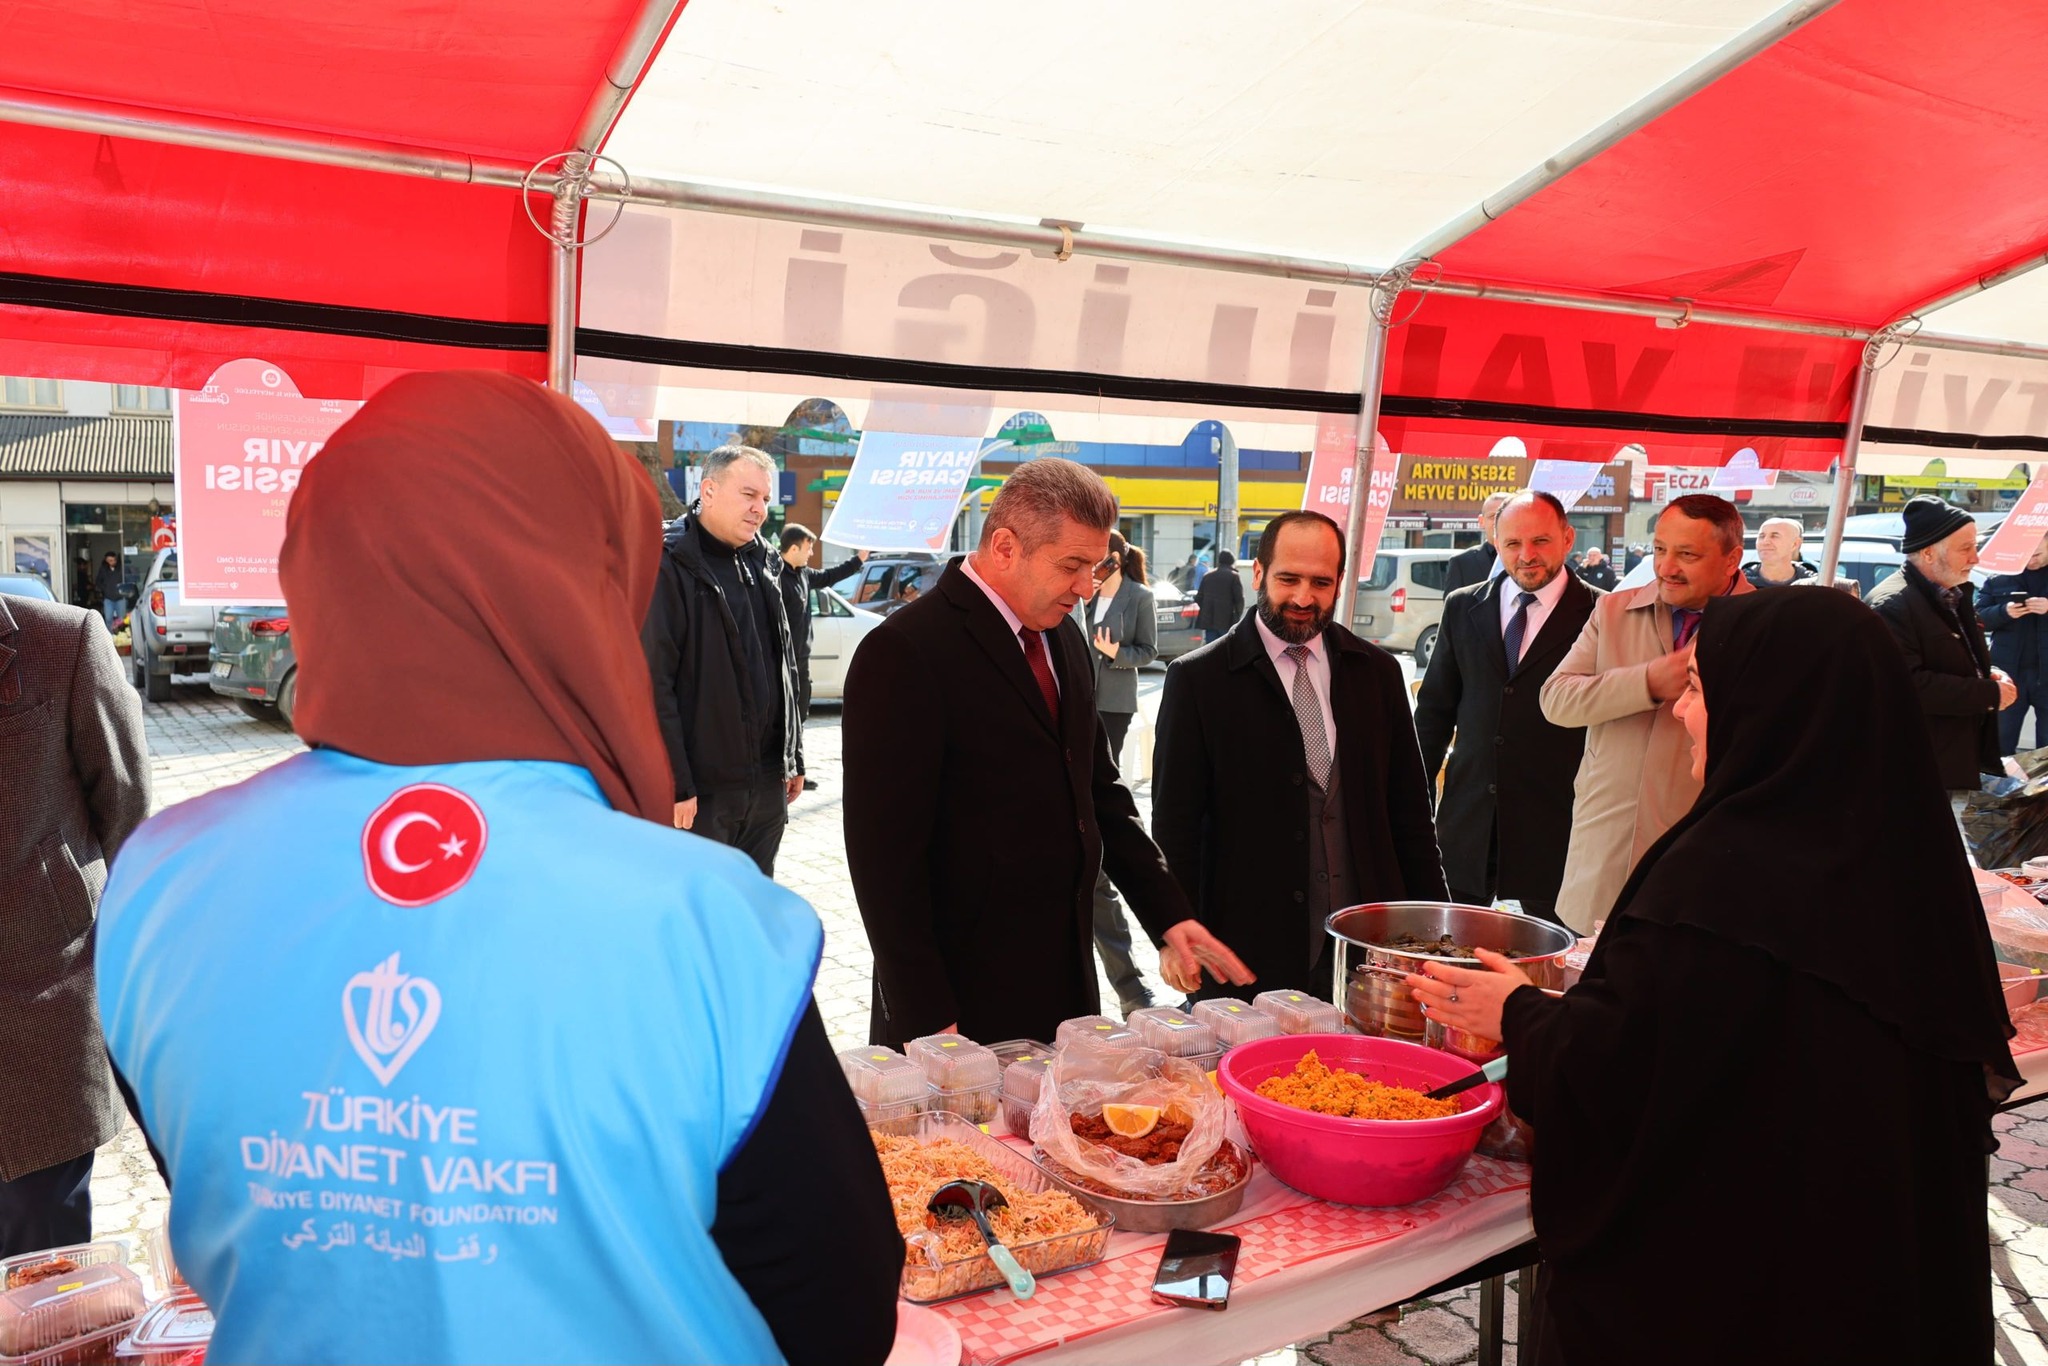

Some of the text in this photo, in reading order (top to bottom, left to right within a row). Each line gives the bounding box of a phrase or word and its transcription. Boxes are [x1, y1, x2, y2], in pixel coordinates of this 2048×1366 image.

[1411, 462, 1468, 480] ARTVİN
[1471, 464, 1517, 482] SEBZE
[1404, 484, 1455, 500] MEYVE
[301, 1087, 478, 1145] TÜRKİYE
[240, 1131, 558, 1196] DİYANET VAKFI
[319, 1191, 402, 1218] DIYANET
[410, 1202, 558, 1226] FOUNDATION
[281, 1218, 356, 1250] التركي
[364, 1223, 426, 1262] الديانة
